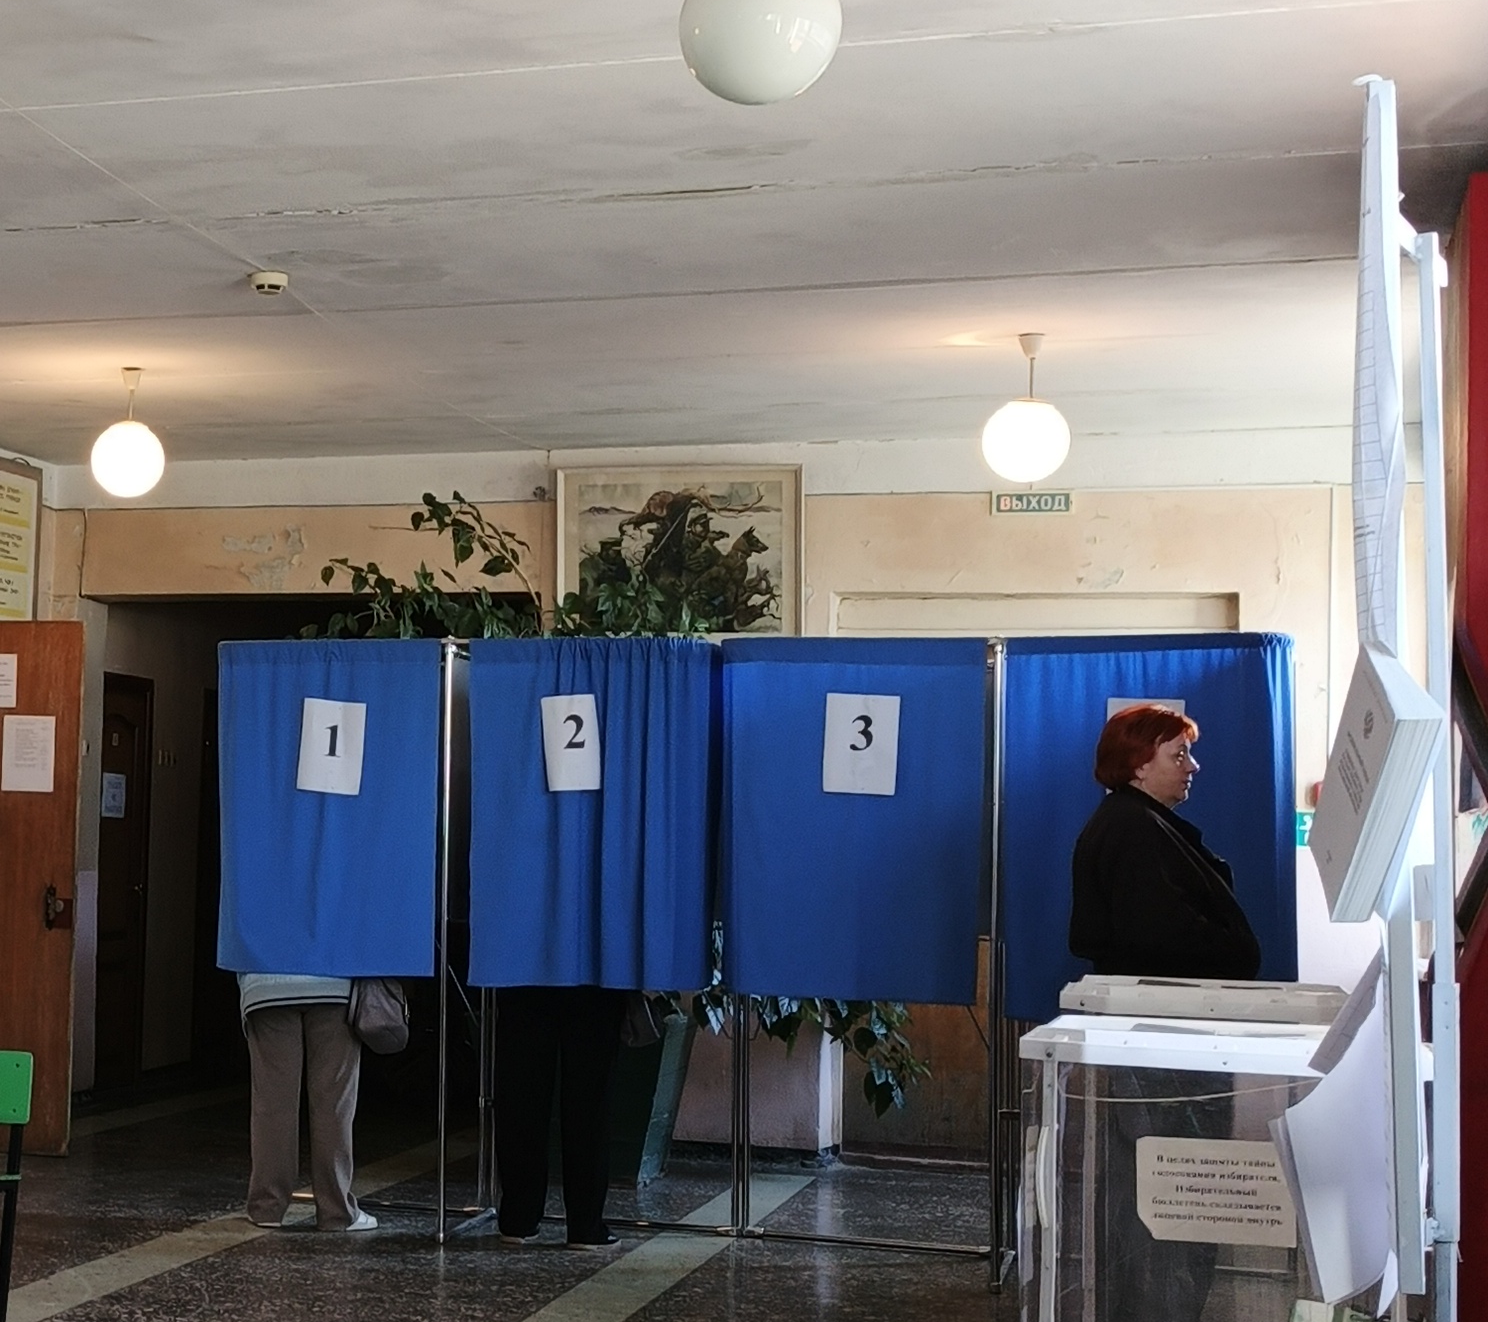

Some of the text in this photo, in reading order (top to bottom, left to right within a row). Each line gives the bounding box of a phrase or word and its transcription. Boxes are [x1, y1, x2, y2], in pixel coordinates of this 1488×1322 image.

[1000, 495, 1066, 511] ВЫХОД
[324, 723, 342, 758] 1
[562, 713, 587, 750] 2
[849, 714, 874, 752] 3
